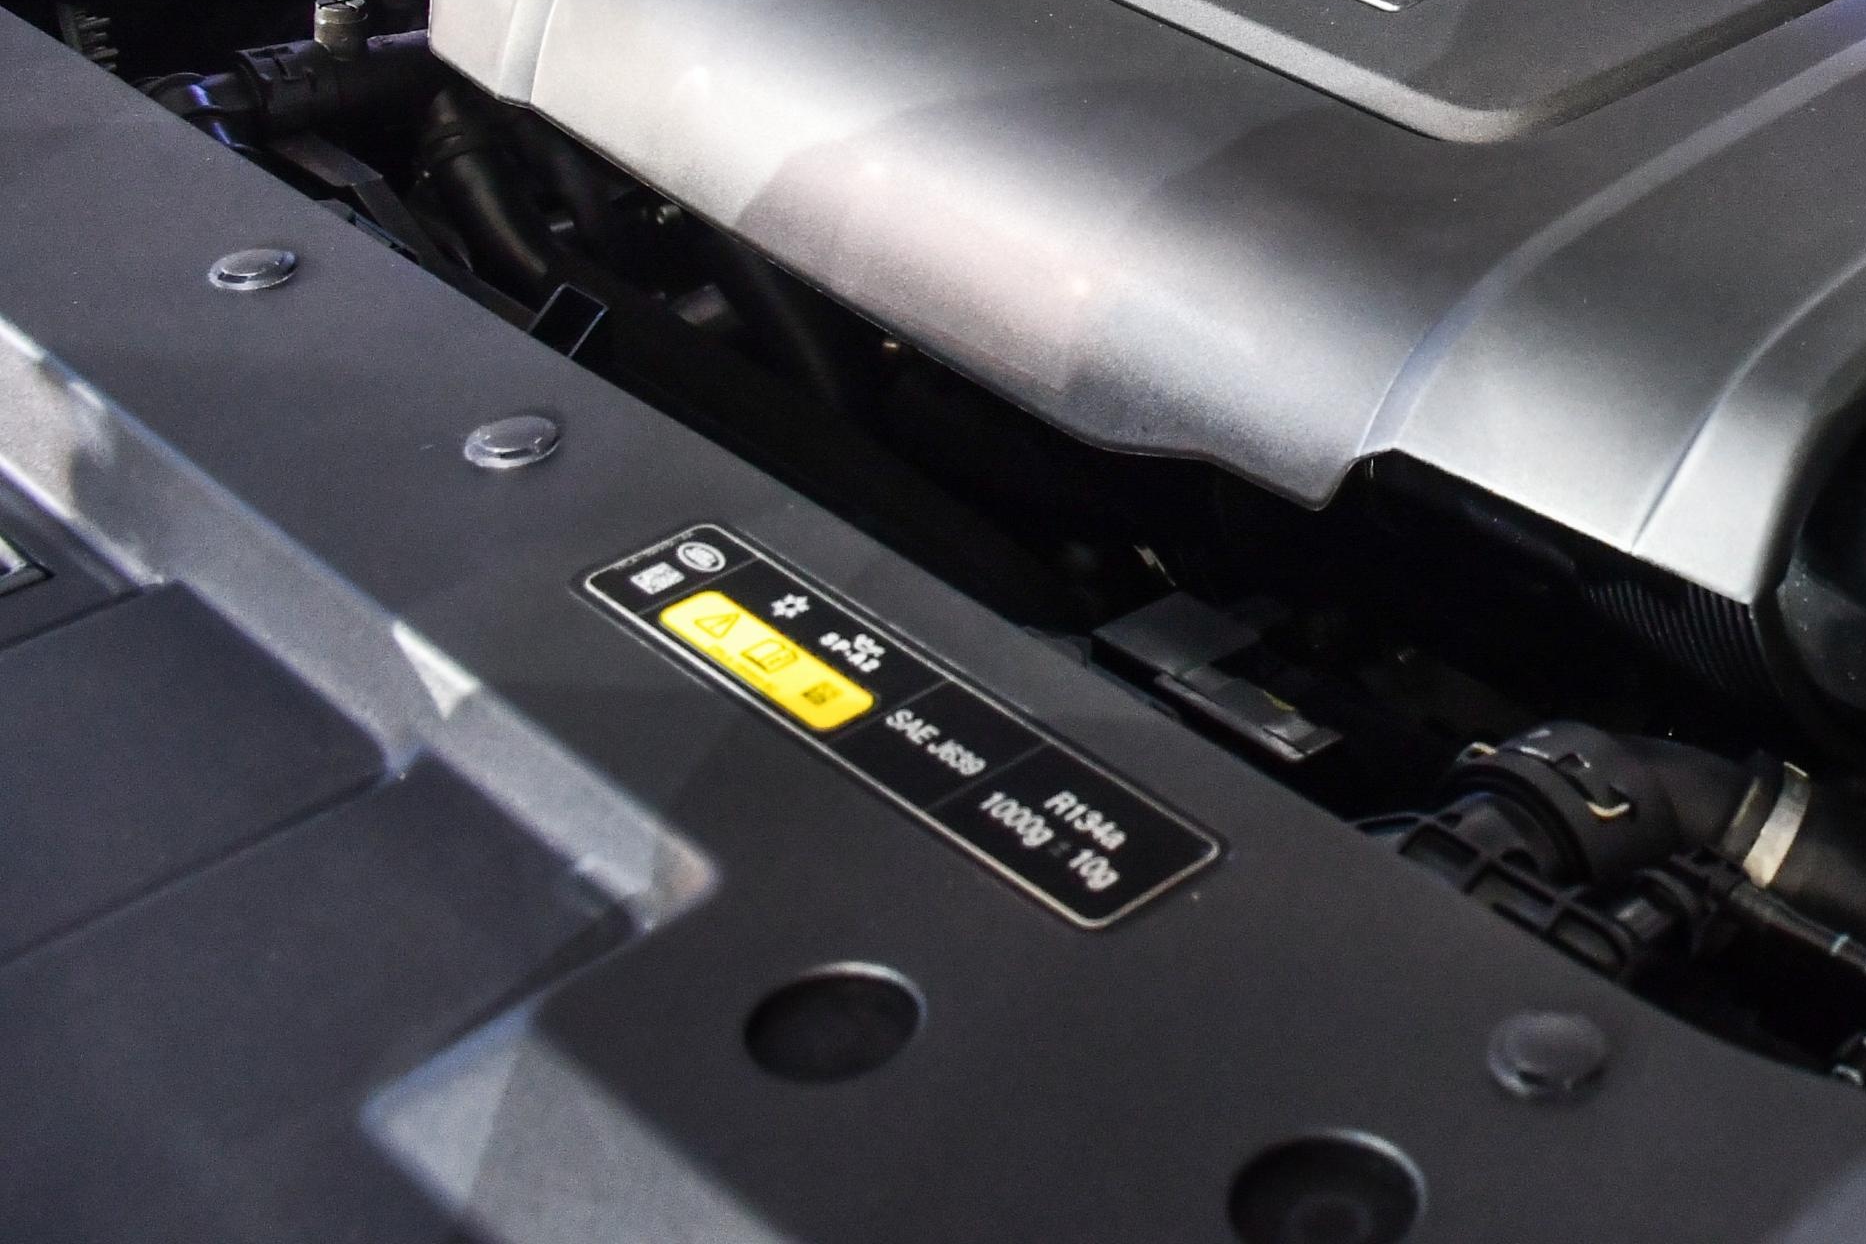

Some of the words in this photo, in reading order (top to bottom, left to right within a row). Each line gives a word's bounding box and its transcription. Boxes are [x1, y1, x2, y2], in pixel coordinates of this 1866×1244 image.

[885, 708, 940, 746] SAE
[978, 791, 1056, 849] 1000g
[1067, 848, 1121, 892] 10g
[1043, 790, 1127, 851] R134a
